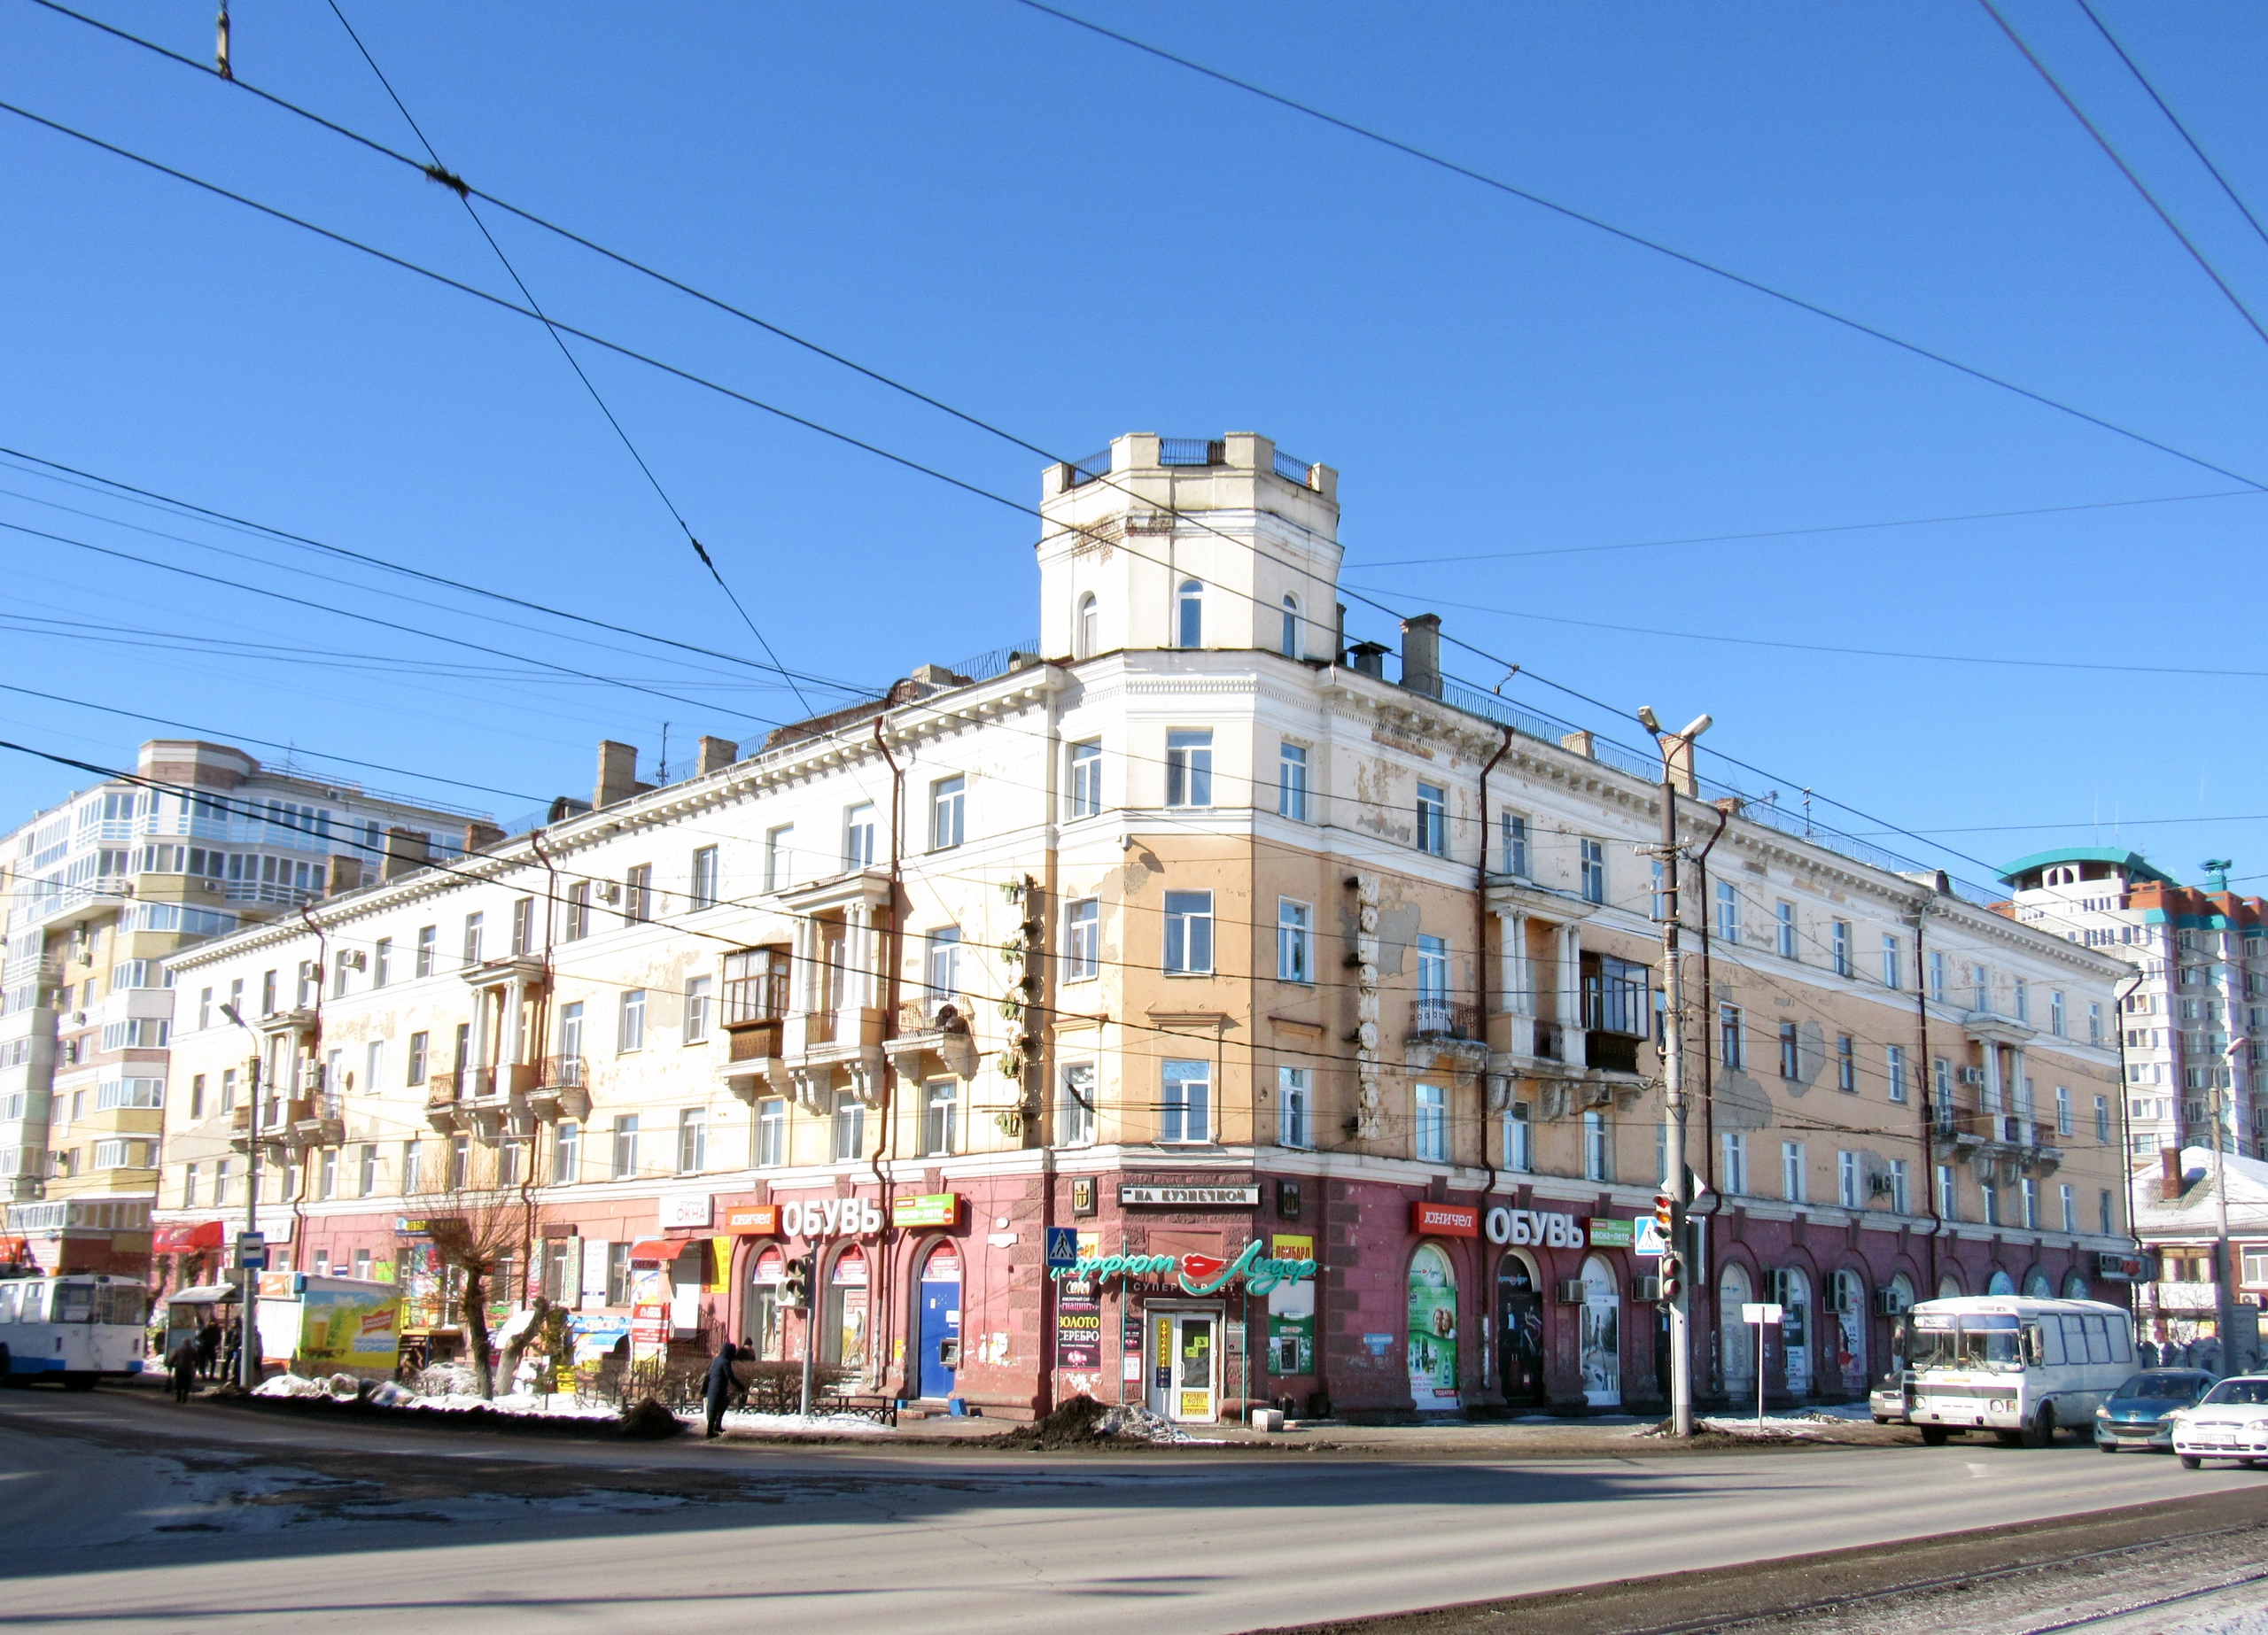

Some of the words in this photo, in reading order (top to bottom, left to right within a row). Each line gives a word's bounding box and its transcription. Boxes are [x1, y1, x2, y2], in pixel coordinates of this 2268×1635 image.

[677, 1208, 705, 1221] ОКНА
[1135, 1189, 1153, 1202] НА
[1161, 1189, 1247, 1202] КУЗНЕЧНОЙ
[782, 1197, 883, 1236] ОБУВЬ
[1485, 1207, 1584, 1249] ОБУВЬ
[1178, 1239, 1317, 1296] Лидер
